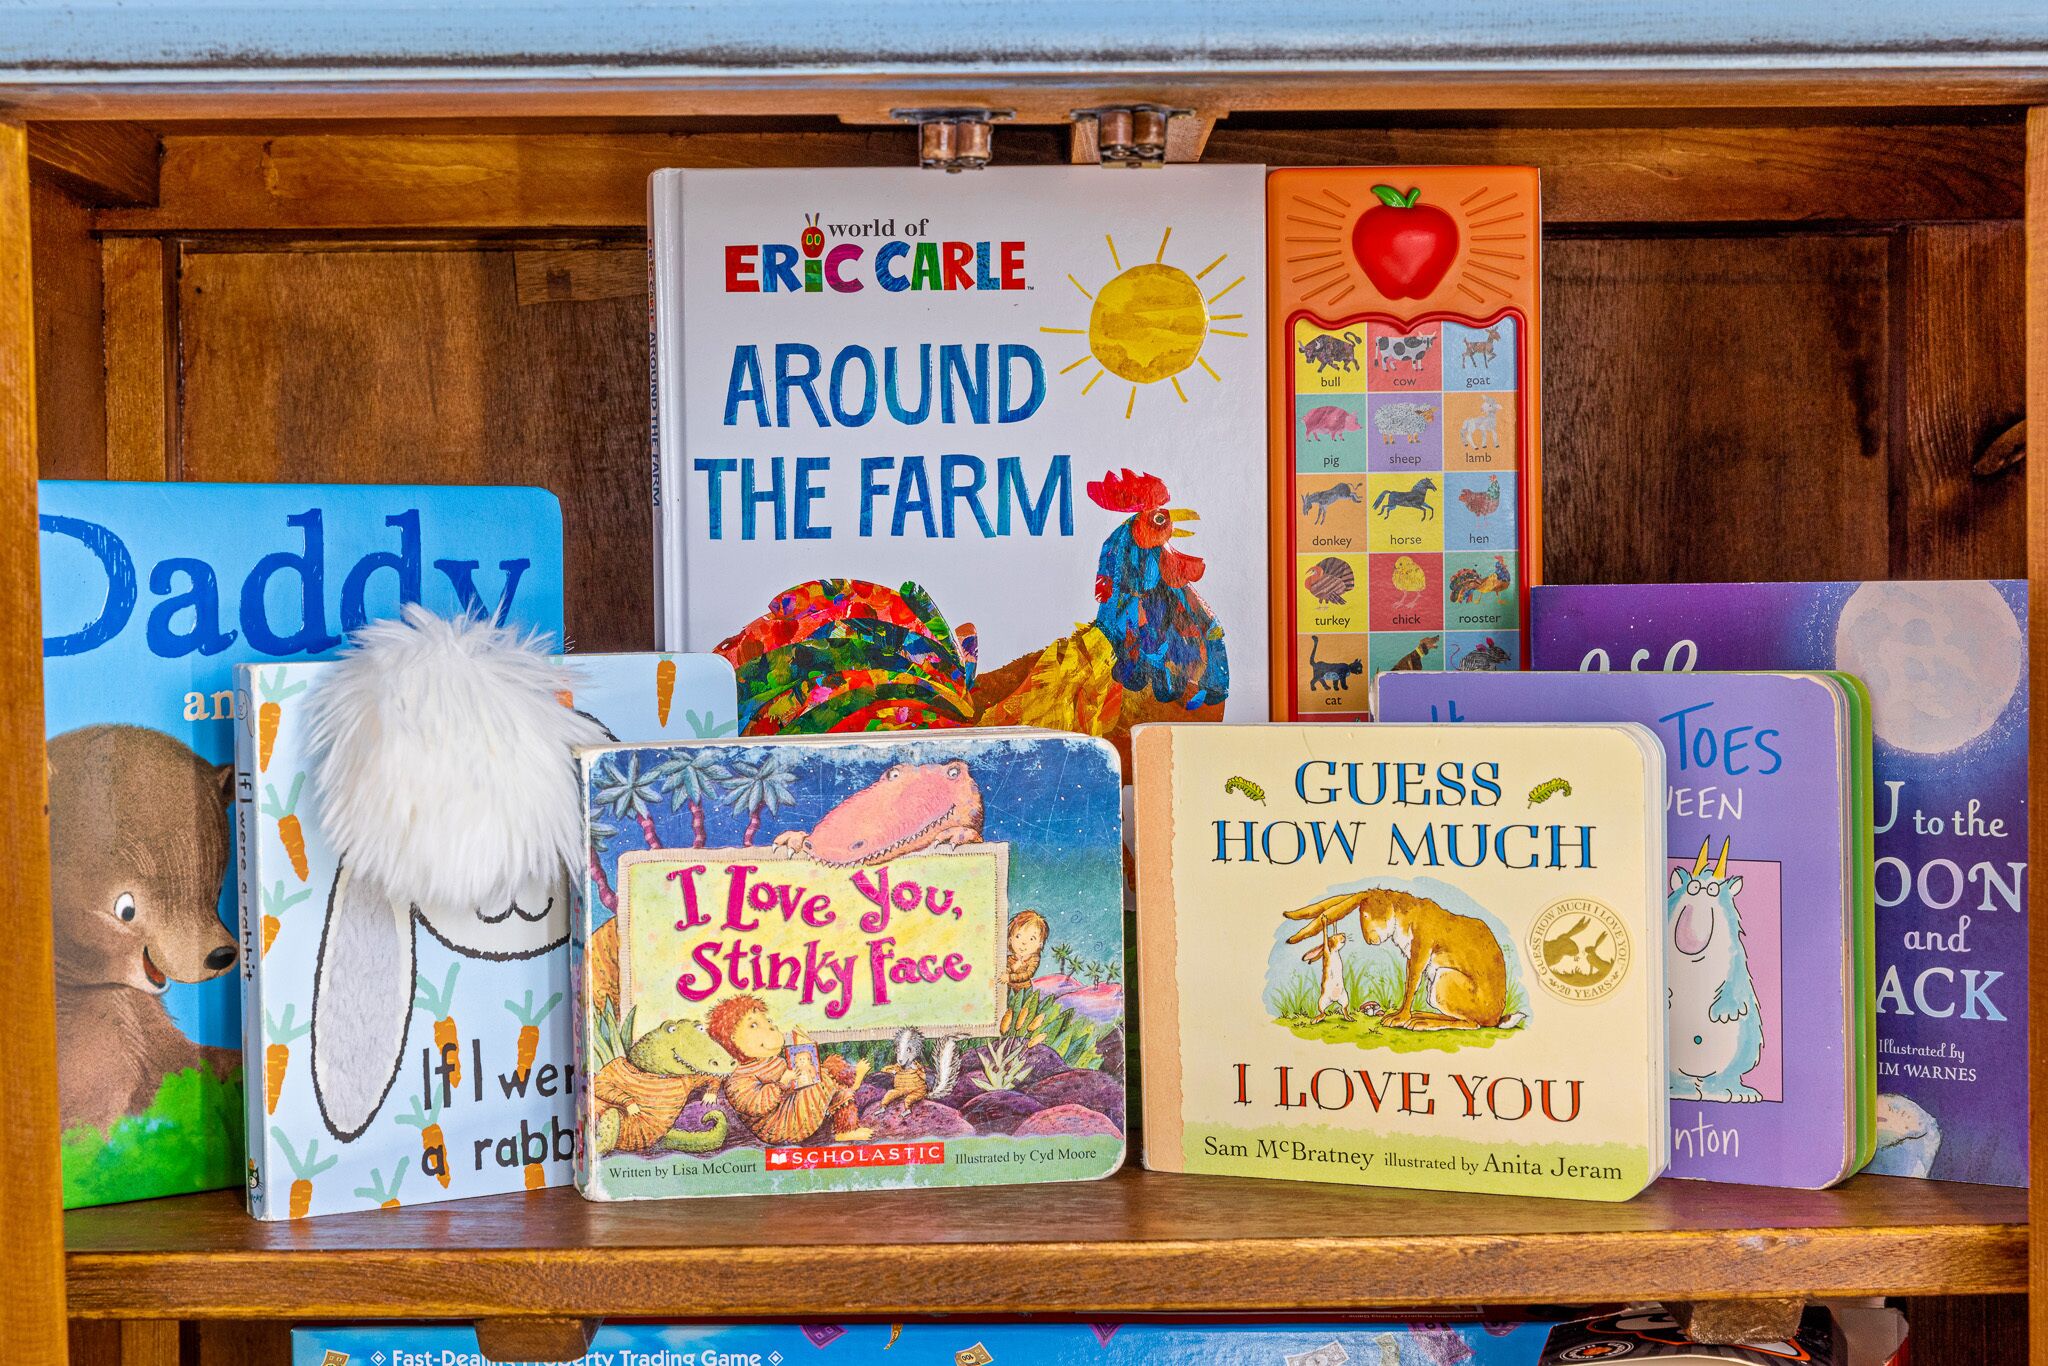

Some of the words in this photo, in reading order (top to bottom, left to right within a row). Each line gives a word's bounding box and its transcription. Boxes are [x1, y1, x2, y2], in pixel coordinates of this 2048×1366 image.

[829, 219, 896, 237] world
[904, 218, 929, 237] of
[875, 241, 1026, 292] CARLE
[650, 332, 660, 408] AROUND
[1320, 376, 1341, 387] bull
[1393, 378, 1416, 387] cow
[1466, 376, 1491, 388] goat
[723, 343, 1048, 428] AROUND
[651, 412, 661, 447] THE
[1323, 455, 1340, 468] pig
[1389, 454, 1422, 466] sheep
[1465, 452, 1492, 463] lamb
[651, 454, 661, 507] FARM
[694, 456, 832, 540] THE
[859, 455, 1074, 538] FARM
[1312, 535, 1352, 549] donkey
[1390, 535, 1422, 545] horse
[1469, 533, 1489, 544] hen
[1315, 615, 1351, 628] turkey
[1392, 614, 1421, 625] chick
[1459, 614, 1501, 624] rooster
[183, 690, 235, 721] an
[1325, 696, 1342, 706] cat
[1659, 702, 1782, 775] TOES
[238, 772, 252, 791] If
[1295, 760, 1502, 807] GUESS
[1667, 785, 1743, 820] EEN
[1913, 810, 1944, 836] to
[1951, 799, 2008, 838] the
[239, 812, 247, 870] were
[1212, 819, 1366, 865] HOW
[1388, 822, 1597, 869] MUCH
[241, 884, 248, 895] a
[666, 865, 712, 932] I
[721, 864, 836, 932] Love
[850, 866, 963, 933] You,
[1874, 856, 2028, 913] OON
[1557, 902, 1591, 915] MUCH
[1536, 911, 1555, 937] HOW
[1600, 909, 1624, 940] LOVE
[1904, 915, 1971, 953] and
[240, 905, 253, 982] rabbit
[1532, 938, 1548, 976] GUESS
[1618, 939, 1628, 963] YOU
[675, 940, 859, 1020] Stinky
[866, 936, 972, 1006] Face
[1560, 987, 1571, 996] 20
[1574, 979, 1612, 998] YEARS
[1876, 965, 2007, 1022] ACK
[1879, 1039, 1946, 1058] Illustrated
[1948, 1042, 1965, 1064] by
[423, 1043, 455, 1110] If
[472, 1039, 482, 1102] I
[498, 1063, 575, 1099] wer
[1878, 1062, 1899, 1076] IM
[1903, 1064, 1977, 1082] WARNES
[1233, 1063, 1252, 1106] I
[1274, 1066, 1435, 1115] LOVE
[1448, 1074, 1584, 1122] YOU
[421, 1144, 445, 1176] a
[473, 1116, 576, 1170] rabb
[1675, 1111, 1739, 1158] nton
[792, 1146, 940, 1164] SCHOLASTIC
[955, 1153, 1010, 1164] Illustrated
[1013, 1152, 1026, 1165] by
[1030, 1149, 1054, 1163] Cyd
[1058, 1148, 1097, 1160] Moore
[1204, 1136, 1248, 1157] Sam
[1256, 1139, 1374, 1171] McBratney
[1384, 1152, 1456, 1170] illustrated
[1461, 1156, 1479, 1175] by
[1483, 1153, 1543, 1175] Anita
[1550, 1157, 1622, 1180] Jeram
[609, 1166, 651, 1179] Written
[655, 1166, 668, 1179] by
[672, 1163, 698, 1176] Lisa
[702, 1161, 757, 1174] McCourt
[700, 1350, 761, 1366] Game
